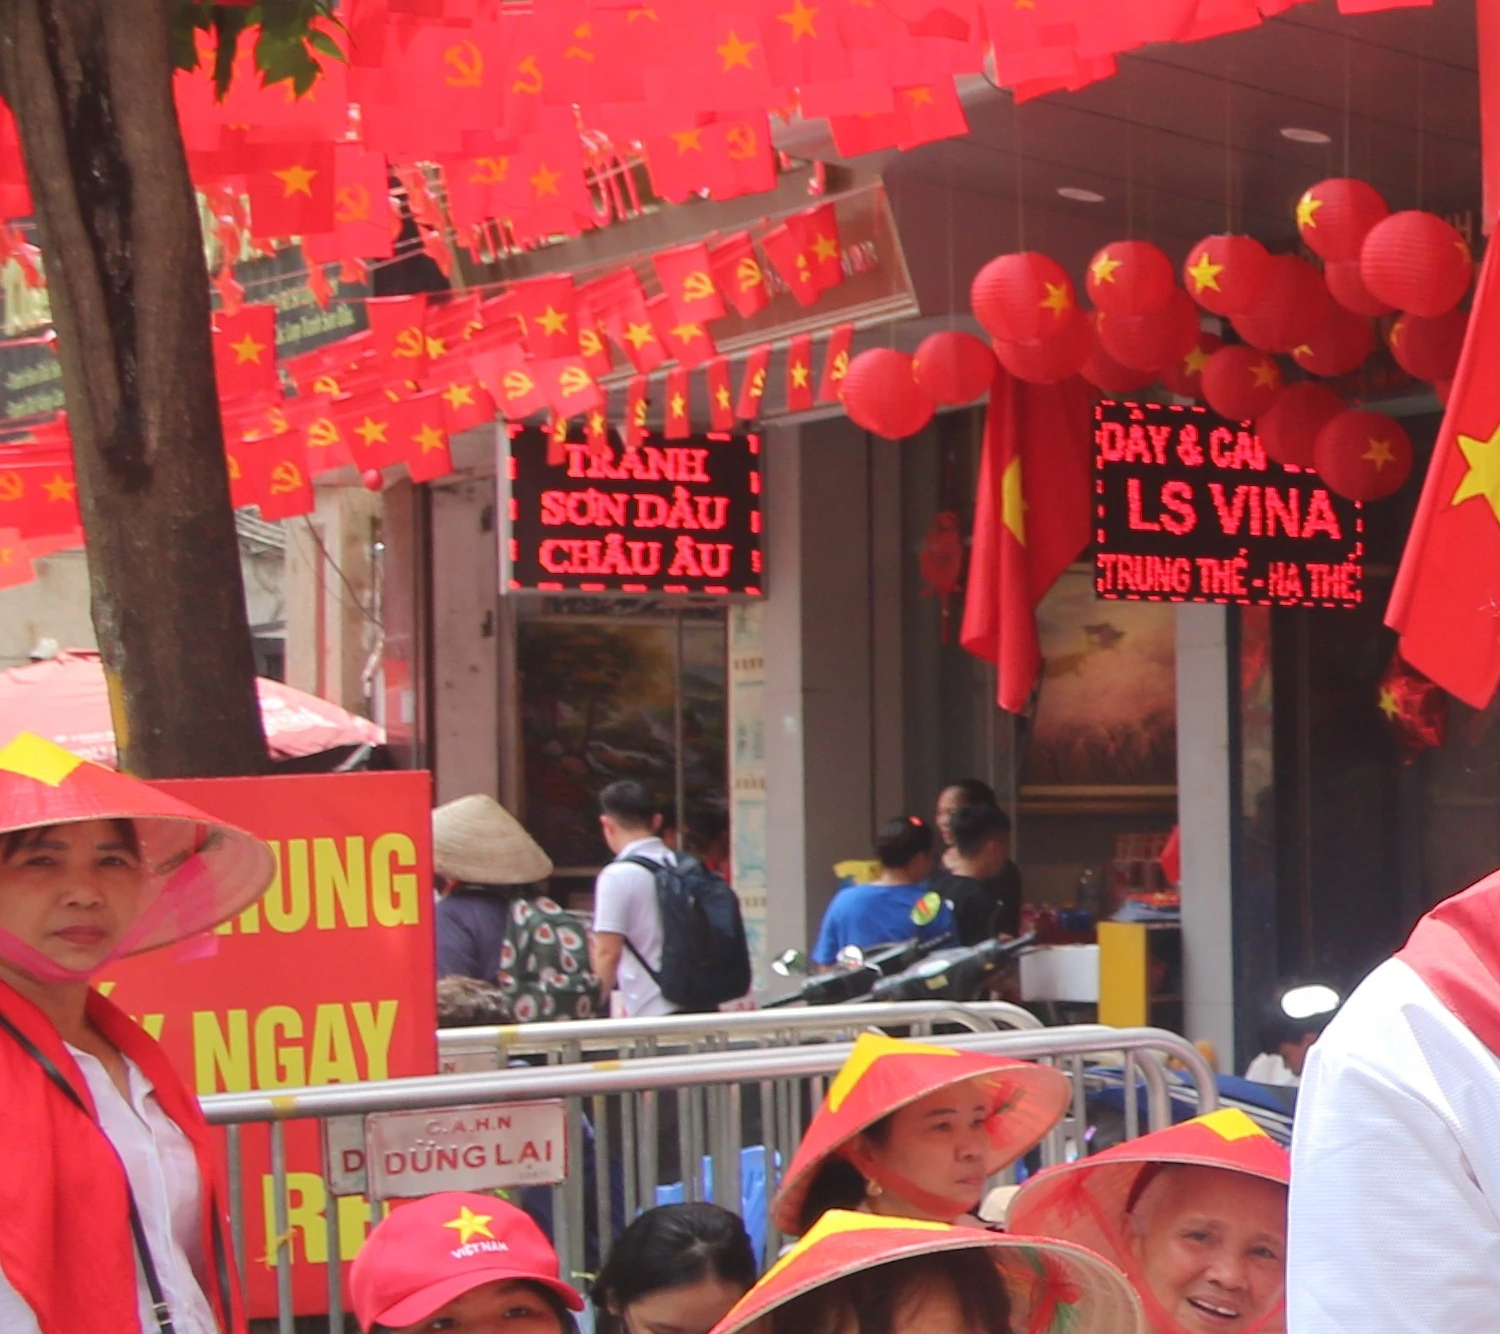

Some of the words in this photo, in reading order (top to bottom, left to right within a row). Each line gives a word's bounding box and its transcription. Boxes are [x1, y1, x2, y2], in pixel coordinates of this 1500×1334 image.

[564, 443, 711, 483] TRANH
[1176, 424, 1204, 466] &
[1126, 477, 1198, 536] LS
[1207, 481, 1342, 540] VINA
[538, 533, 663, 576] CHÂU
[667, 535, 734, 578] ÂU
[1097, 553, 1192, 593] TRUNG
[192, 999, 399, 1093] NGAY
